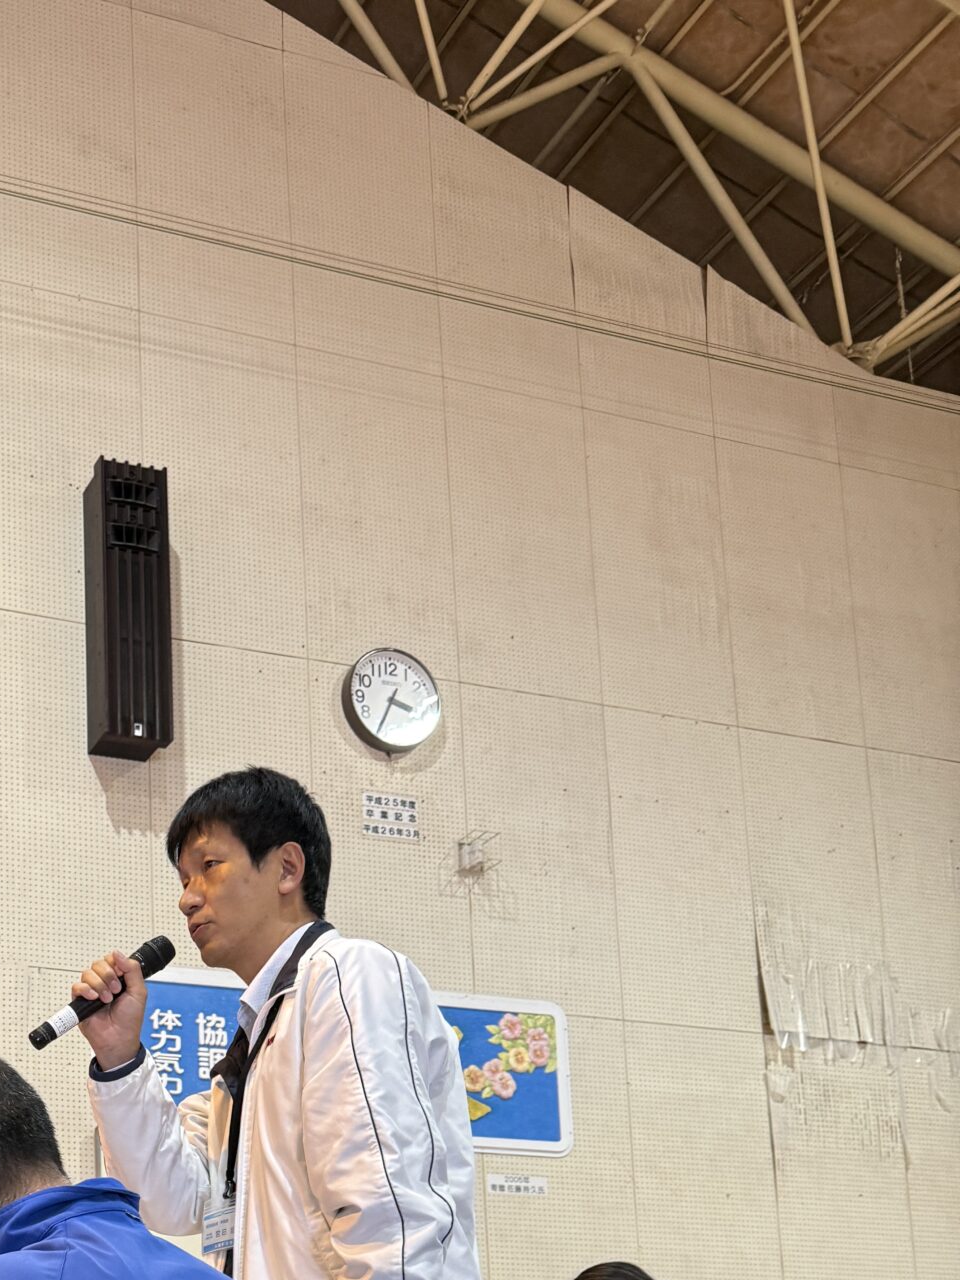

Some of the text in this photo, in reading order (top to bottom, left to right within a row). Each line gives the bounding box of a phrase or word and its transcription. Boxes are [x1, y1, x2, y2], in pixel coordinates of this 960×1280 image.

[371, 663, 382, 678] 11
[384, 661, 398, 677] 12
[358, 673, 372, 688] 10
[412, 680, 422, 692] 2
[354, 688, 365, 703] 9
[360, 704, 371, 719] 8
[365, 795, 417, 809] 平成25年度
[365, 809, 417, 823] 卒業記念
[362, 824, 420, 839] 平成26年3月
